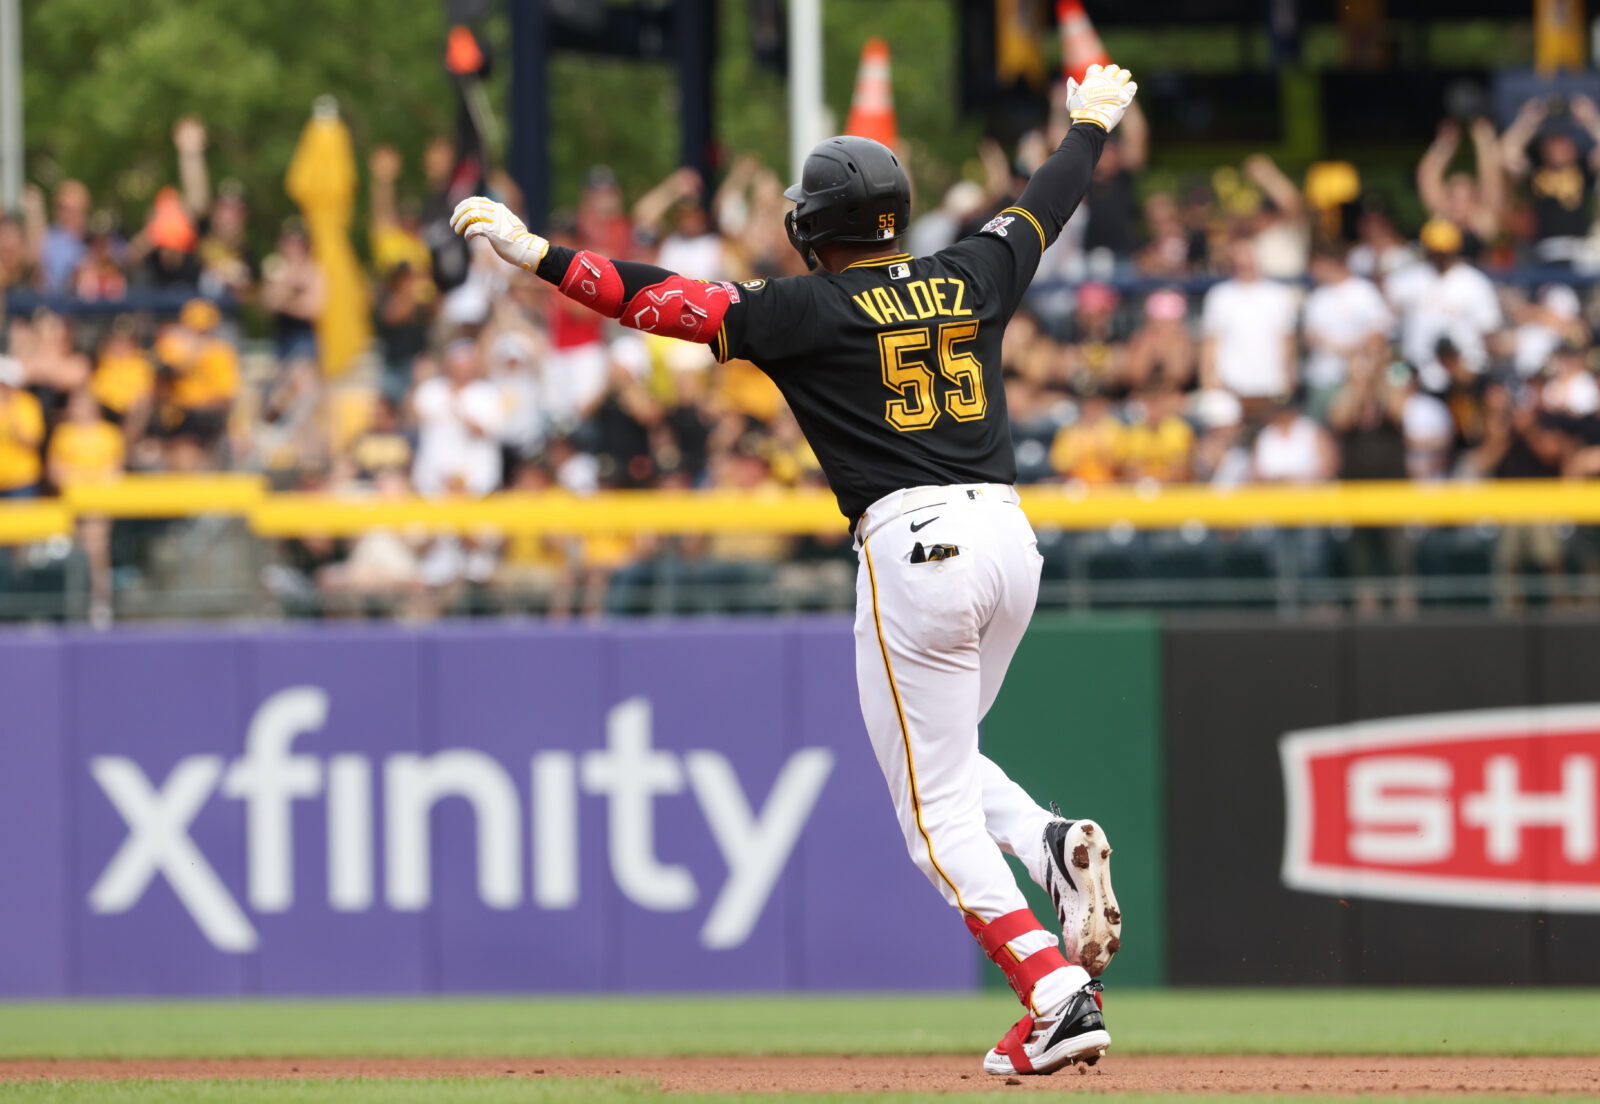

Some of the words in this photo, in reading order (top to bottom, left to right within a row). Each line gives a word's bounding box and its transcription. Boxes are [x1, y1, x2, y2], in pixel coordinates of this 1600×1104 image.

[879, 213, 895, 229] 55
[853, 278, 972, 325] VALDEZ
[877, 319, 987, 432] 55
[88, 685, 836, 954] xfinity
[1346, 752, 1597, 866] SH
